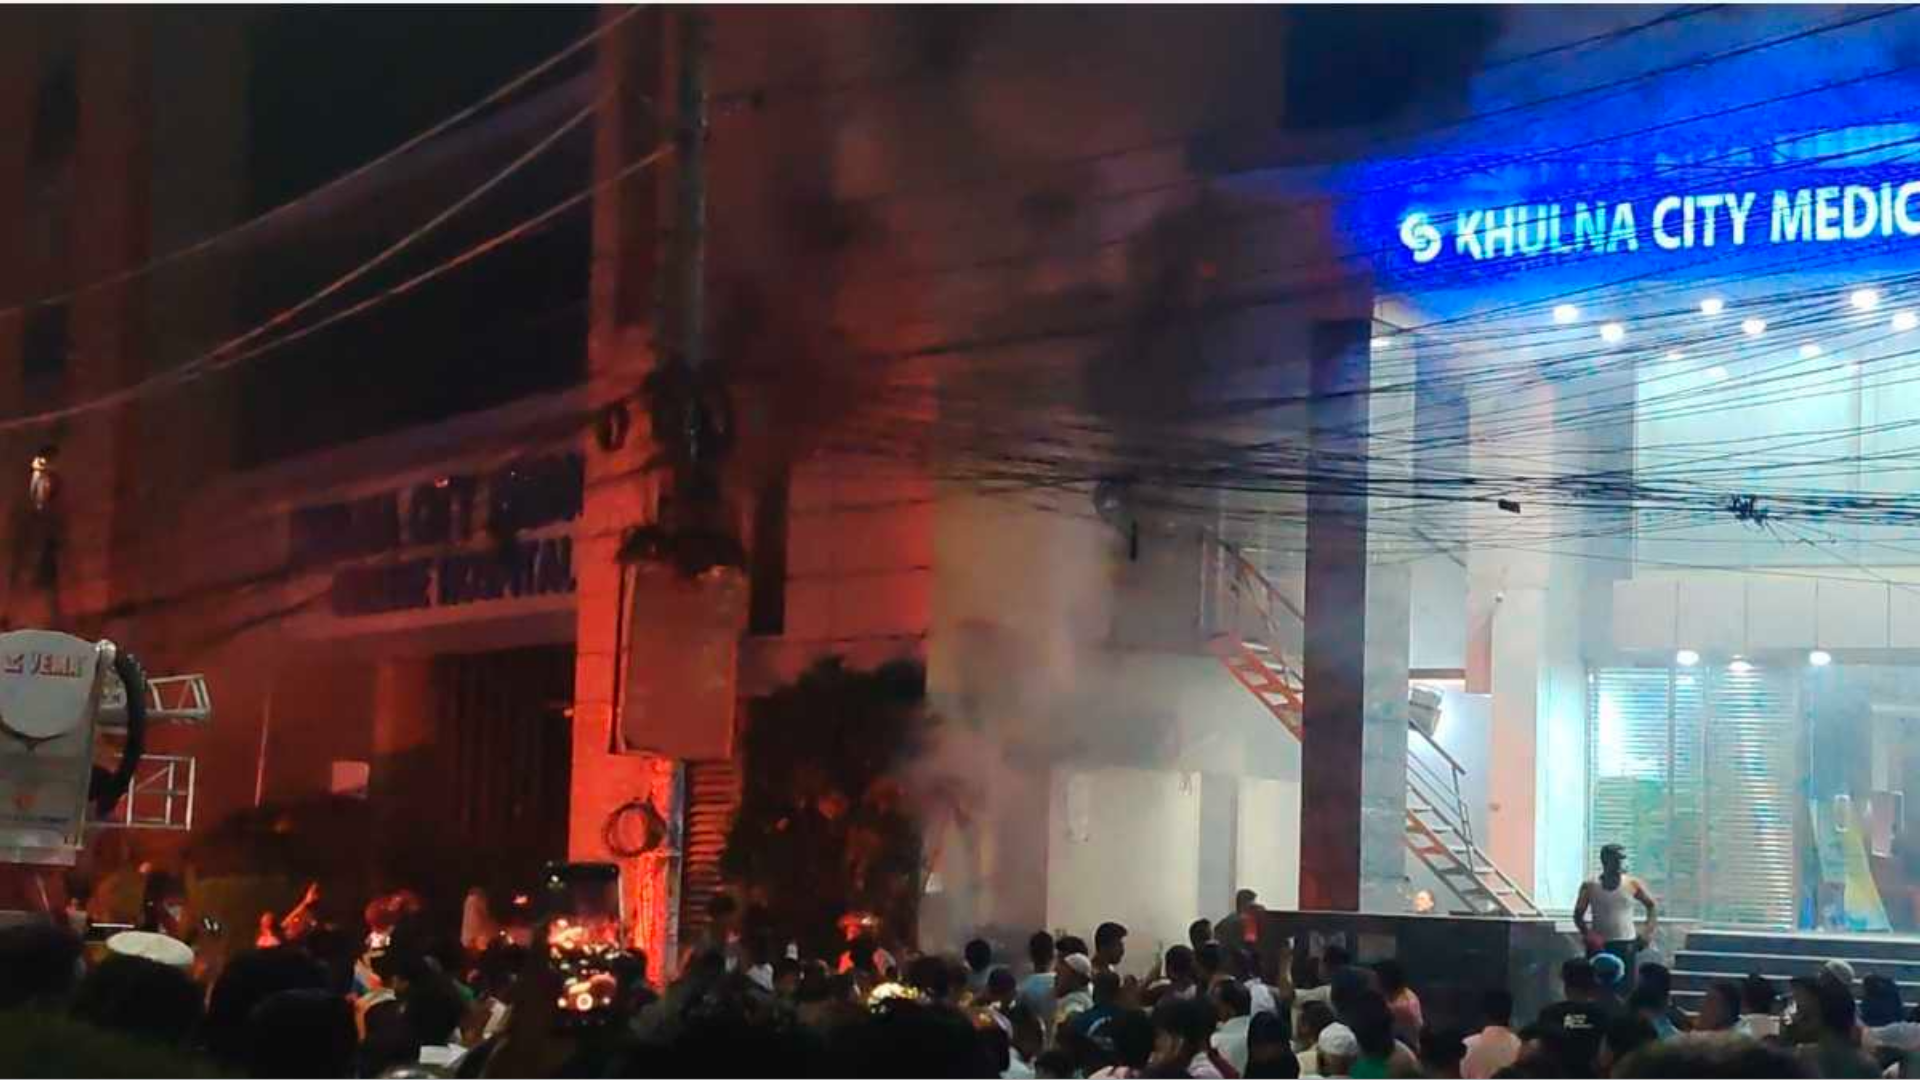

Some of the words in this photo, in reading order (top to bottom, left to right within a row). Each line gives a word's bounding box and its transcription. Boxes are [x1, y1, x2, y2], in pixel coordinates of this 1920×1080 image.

[1456, 202, 1639, 260] KHULNA
[1653, 192, 1756, 249] CITY
[1770, 181, 1920, 242] MEDIC
